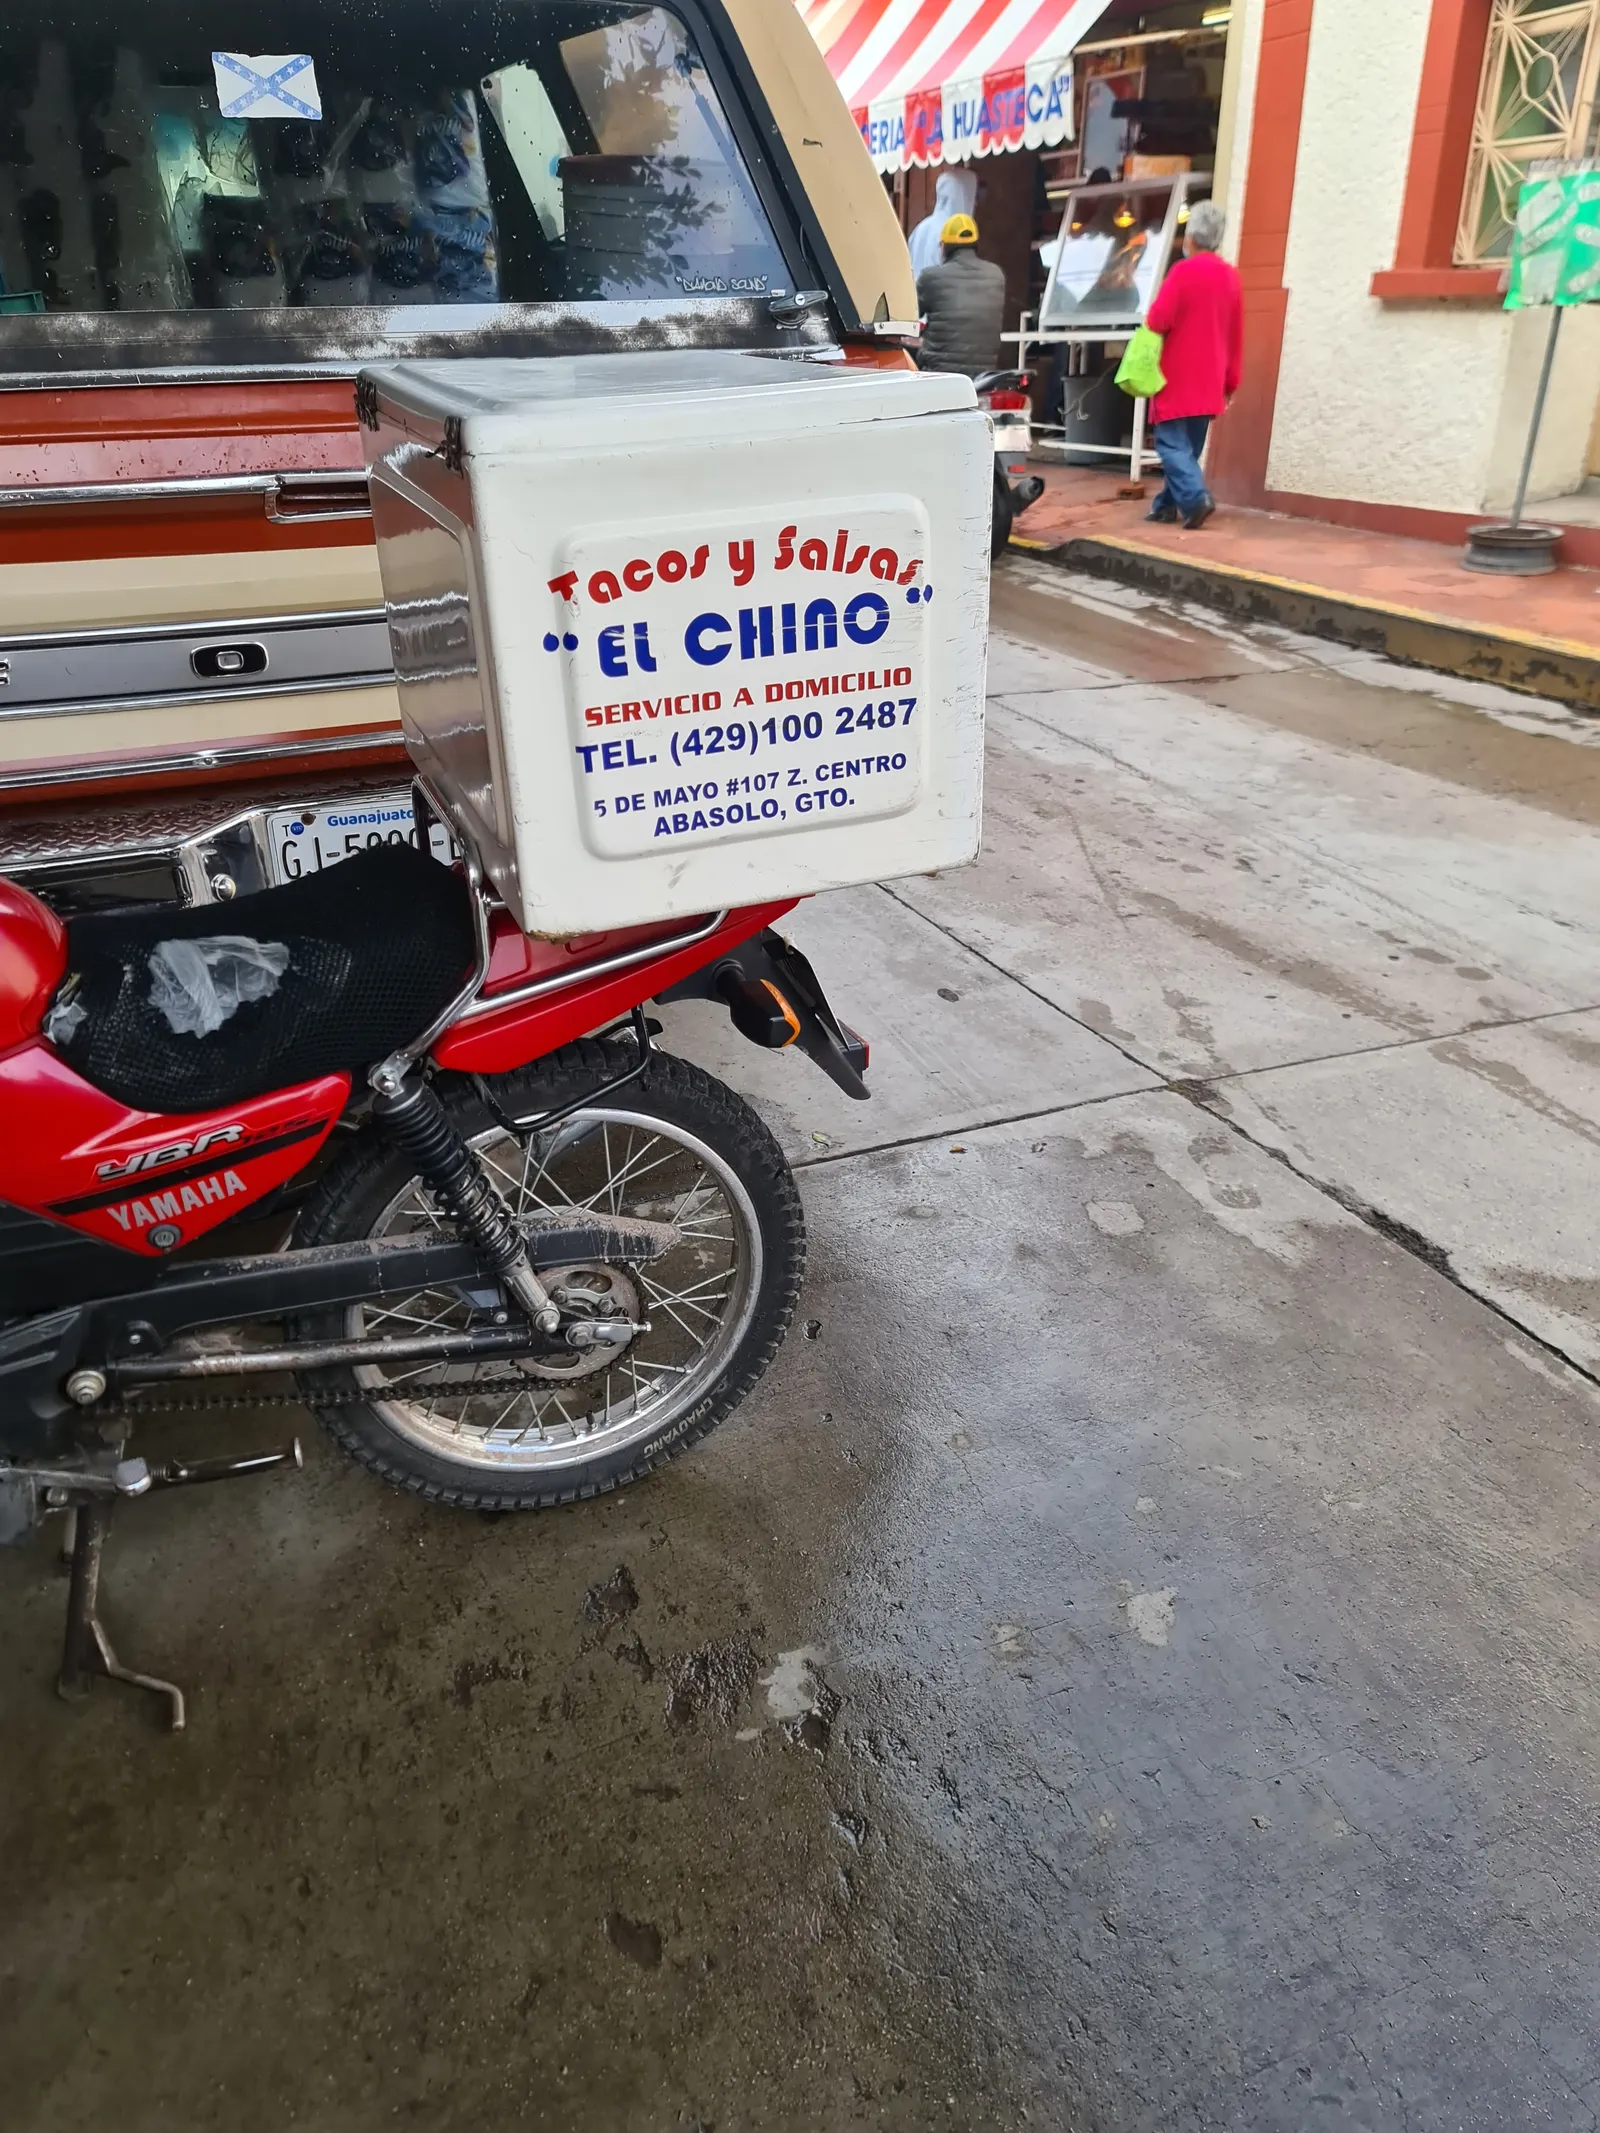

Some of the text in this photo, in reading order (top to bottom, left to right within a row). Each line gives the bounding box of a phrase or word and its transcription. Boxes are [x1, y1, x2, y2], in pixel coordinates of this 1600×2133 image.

[547, 524, 924, 605] Tacos y Salsas
[585, 666, 912, 728] SERVICIO A DOMICILIO
[575, 741, 657, 773] TEL.
[834, 697, 918, 736] 2487
[593, 752, 907, 818] 5 DE MAYO #107 Z. CENTRO
[654, 787, 855, 837] ABASOLO, GTO.
[327, 809, 414, 827] Guanajuato
[97, 1124, 244, 1181] YBR
[107, 1170, 247, 1231] YAMAHA
